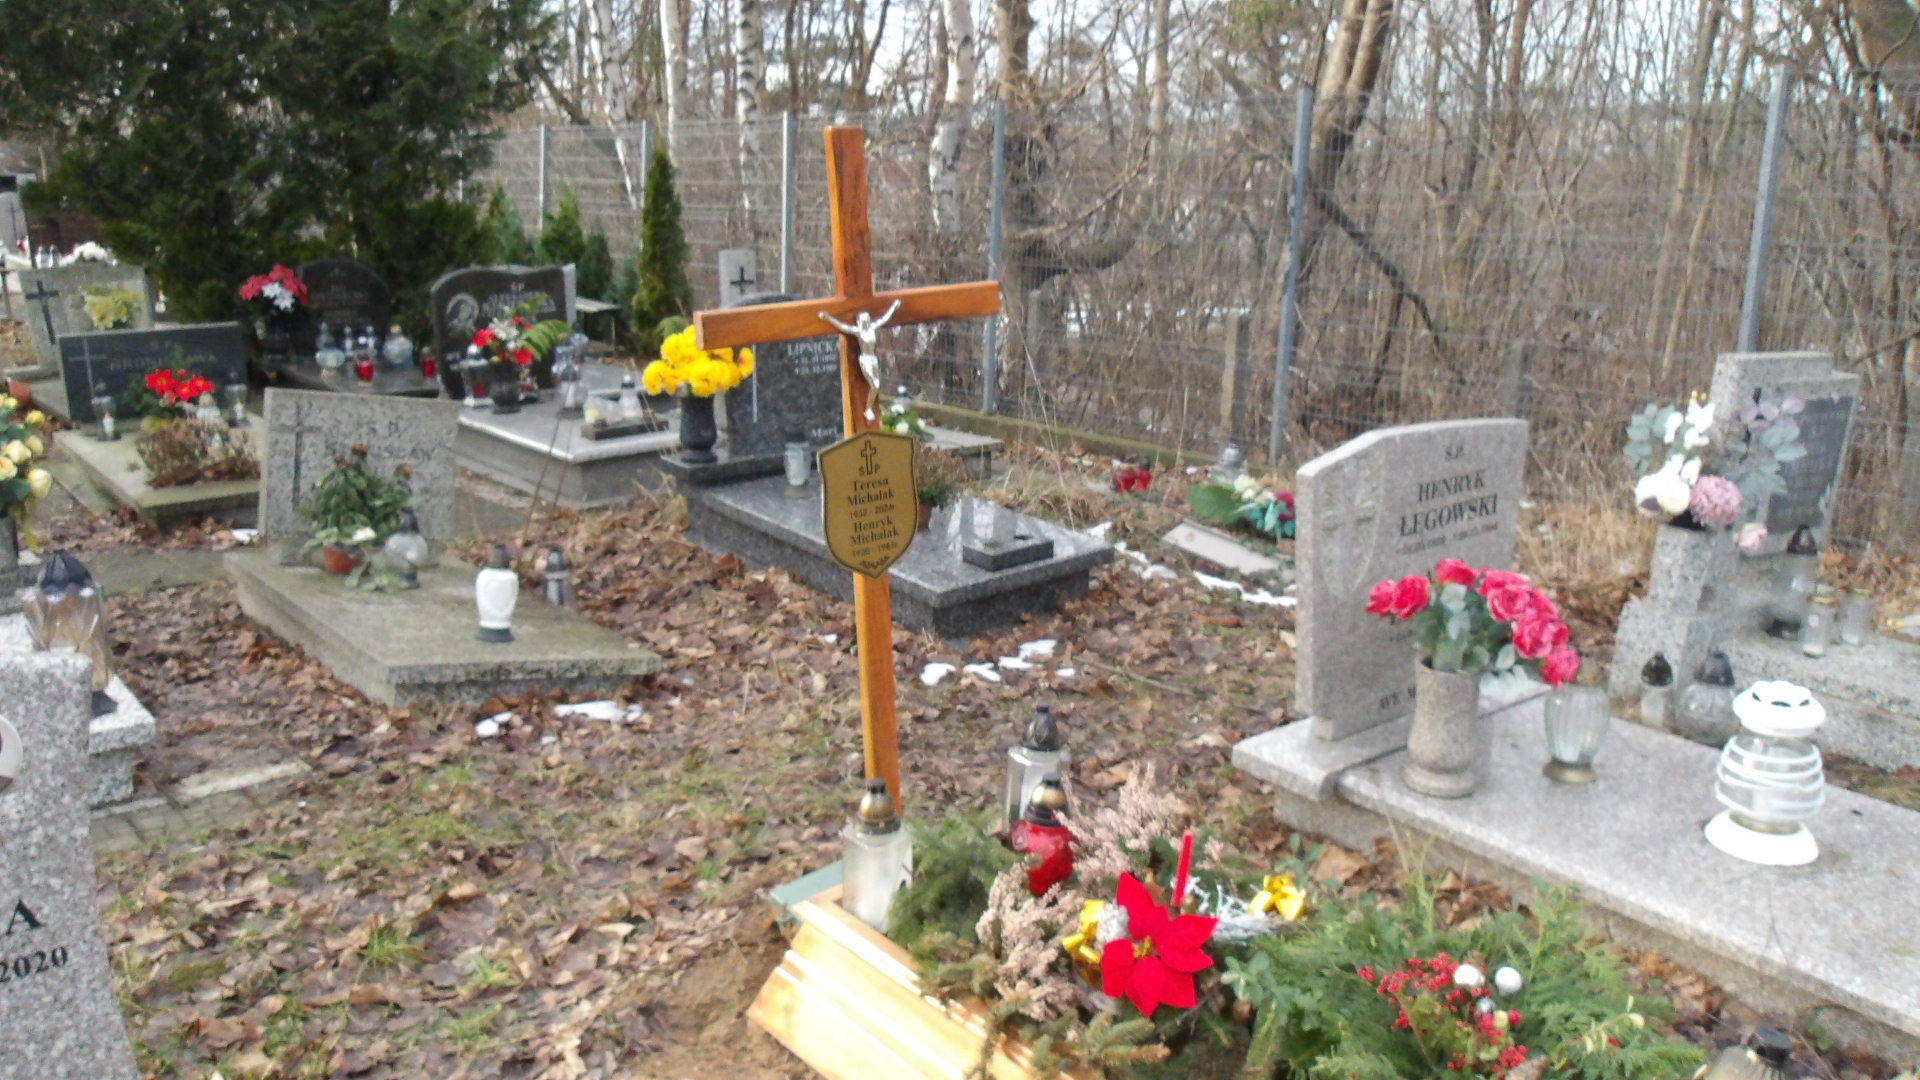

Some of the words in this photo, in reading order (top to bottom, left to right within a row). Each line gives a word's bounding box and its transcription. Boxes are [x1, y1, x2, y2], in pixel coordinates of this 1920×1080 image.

[852, 478, 889, 492] Teresa
[1417, 469, 1486, 502] HENRYK
[847, 487, 895, 506] Michalak
[853, 515, 893, 533] Henryk
[850, 526, 900, 545] Michalak
